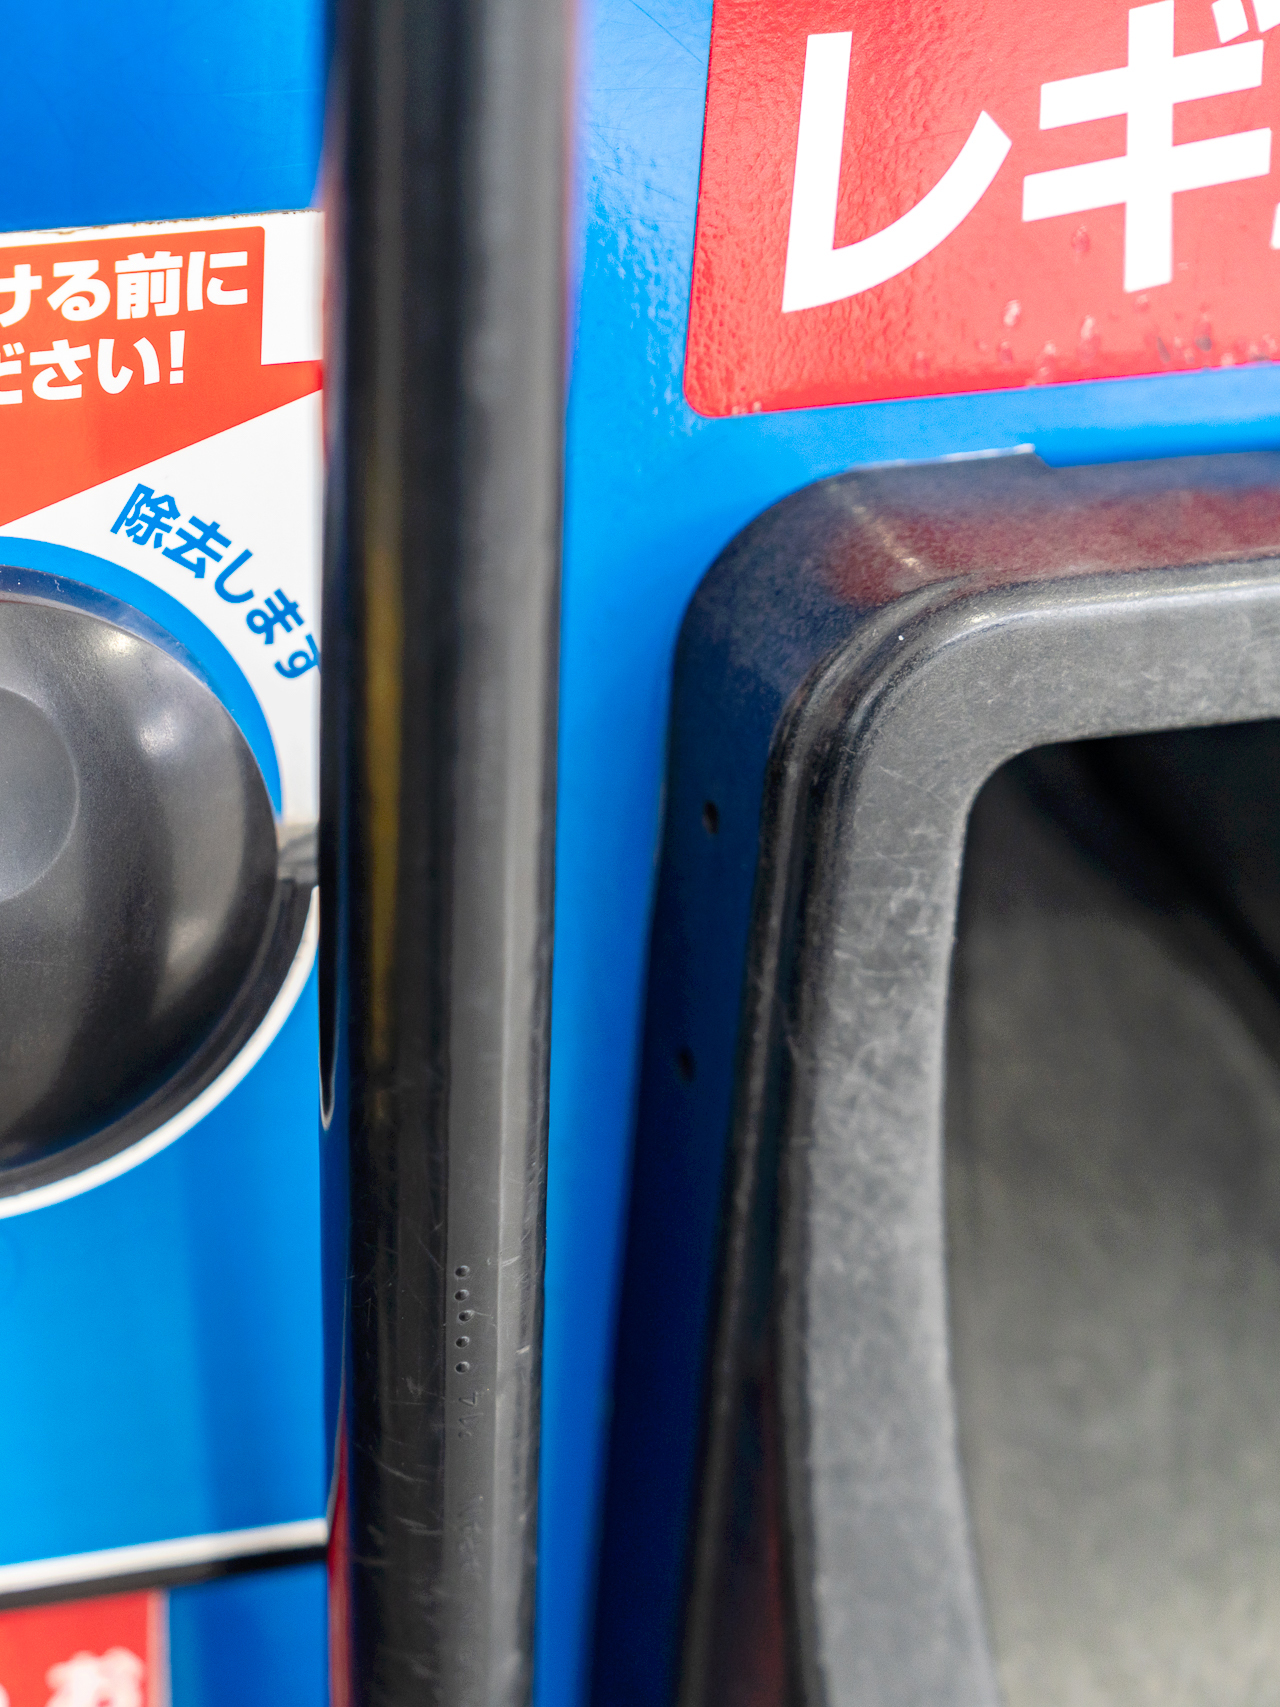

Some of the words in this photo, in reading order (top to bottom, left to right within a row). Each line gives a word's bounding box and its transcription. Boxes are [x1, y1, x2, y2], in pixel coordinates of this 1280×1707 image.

[782, 0, 1280, 313] レギ
[110, 483, 321, 678] 除去します
